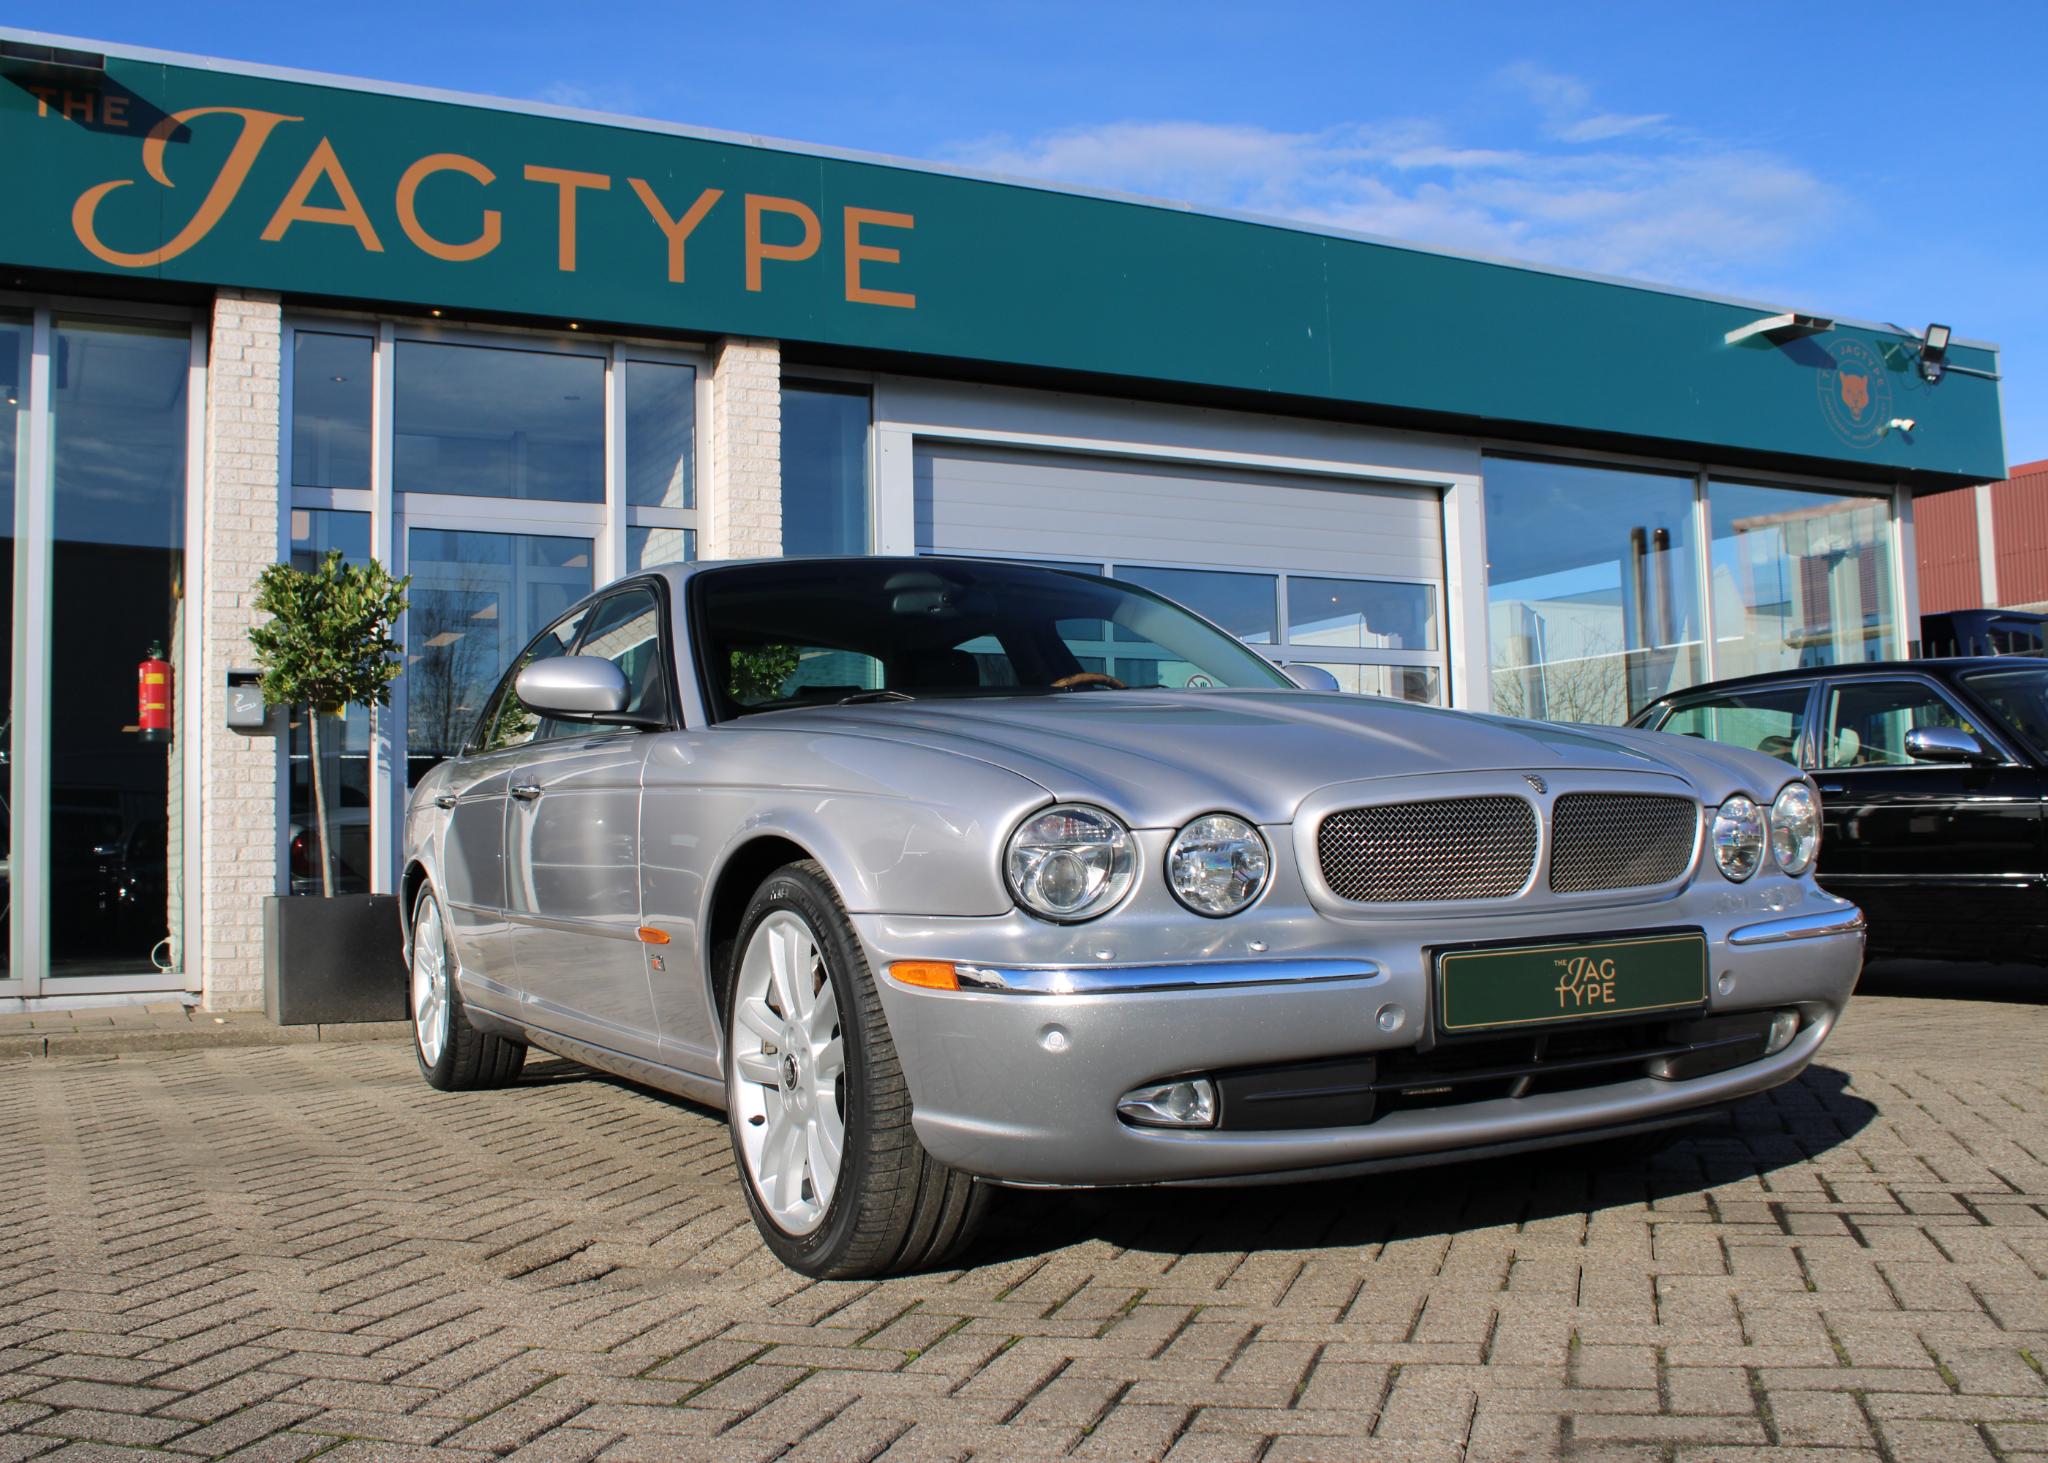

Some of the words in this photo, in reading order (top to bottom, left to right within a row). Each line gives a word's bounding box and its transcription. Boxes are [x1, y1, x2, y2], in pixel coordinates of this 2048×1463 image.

[29, 86, 129, 127] THE
[71, 106, 916, 309] JAGTYPE
[1554, 959, 1568, 967] THE
[1560, 956, 1617, 990] JAG
[1554, 981, 1617, 1008] TYPE
